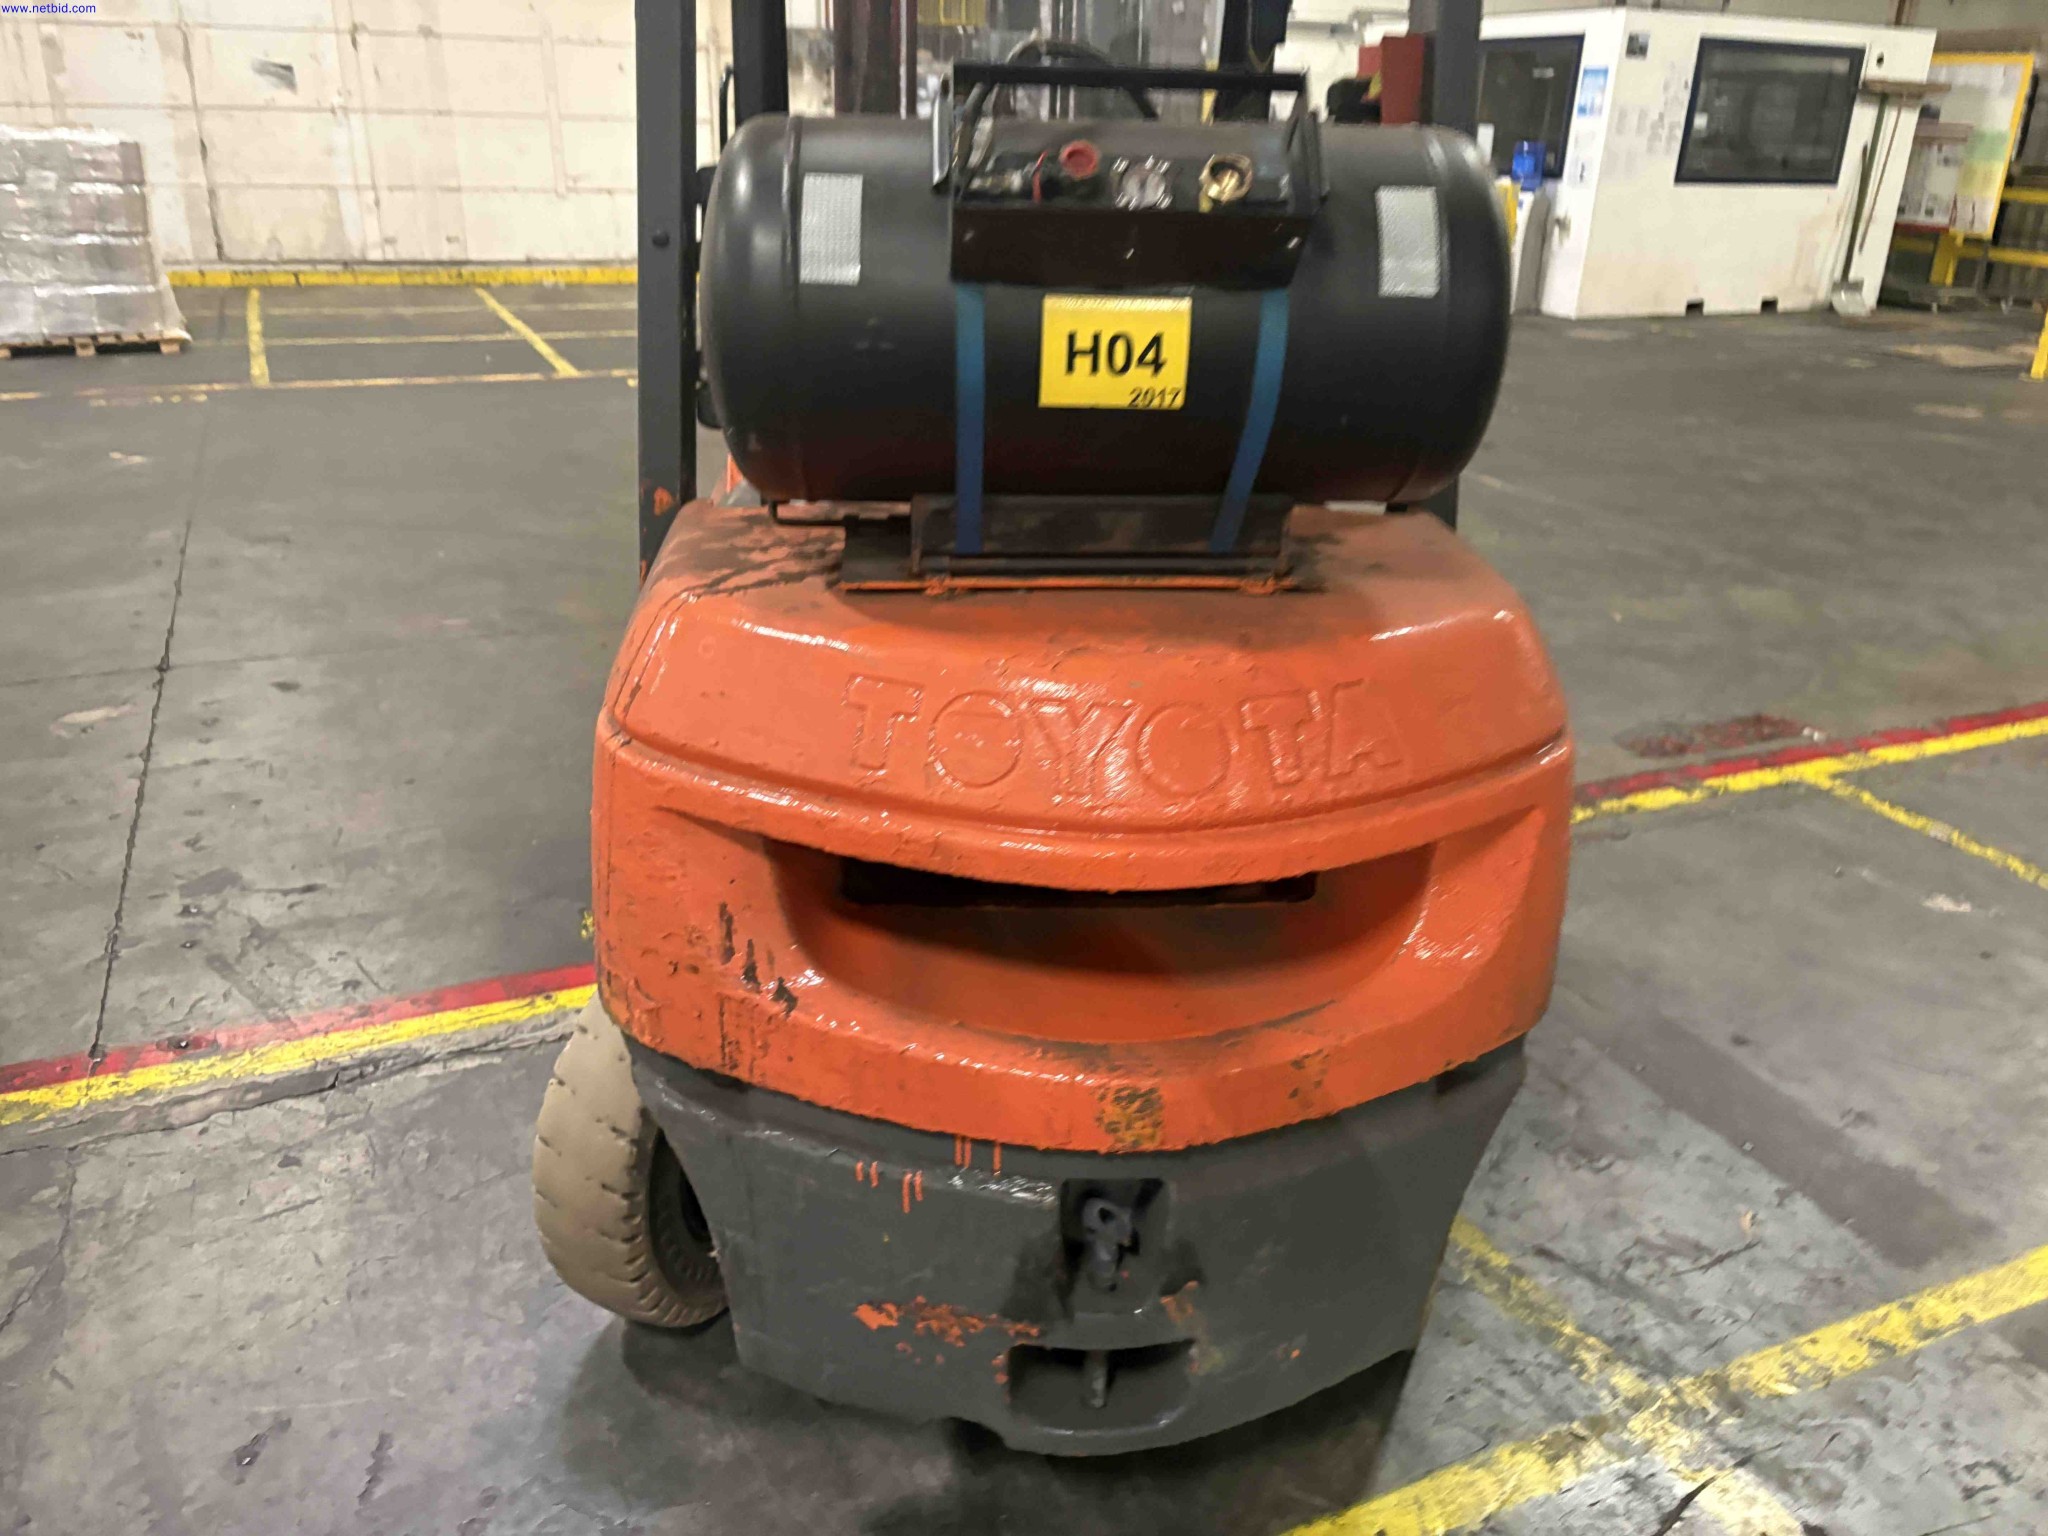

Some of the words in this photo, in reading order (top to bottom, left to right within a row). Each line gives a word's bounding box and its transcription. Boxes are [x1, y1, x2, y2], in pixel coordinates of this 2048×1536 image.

[1066, 330, 1167, 377] H04
[1127, 387, 1181, 409] 2017
[842, 673, 1402, 799] TOYOTA
